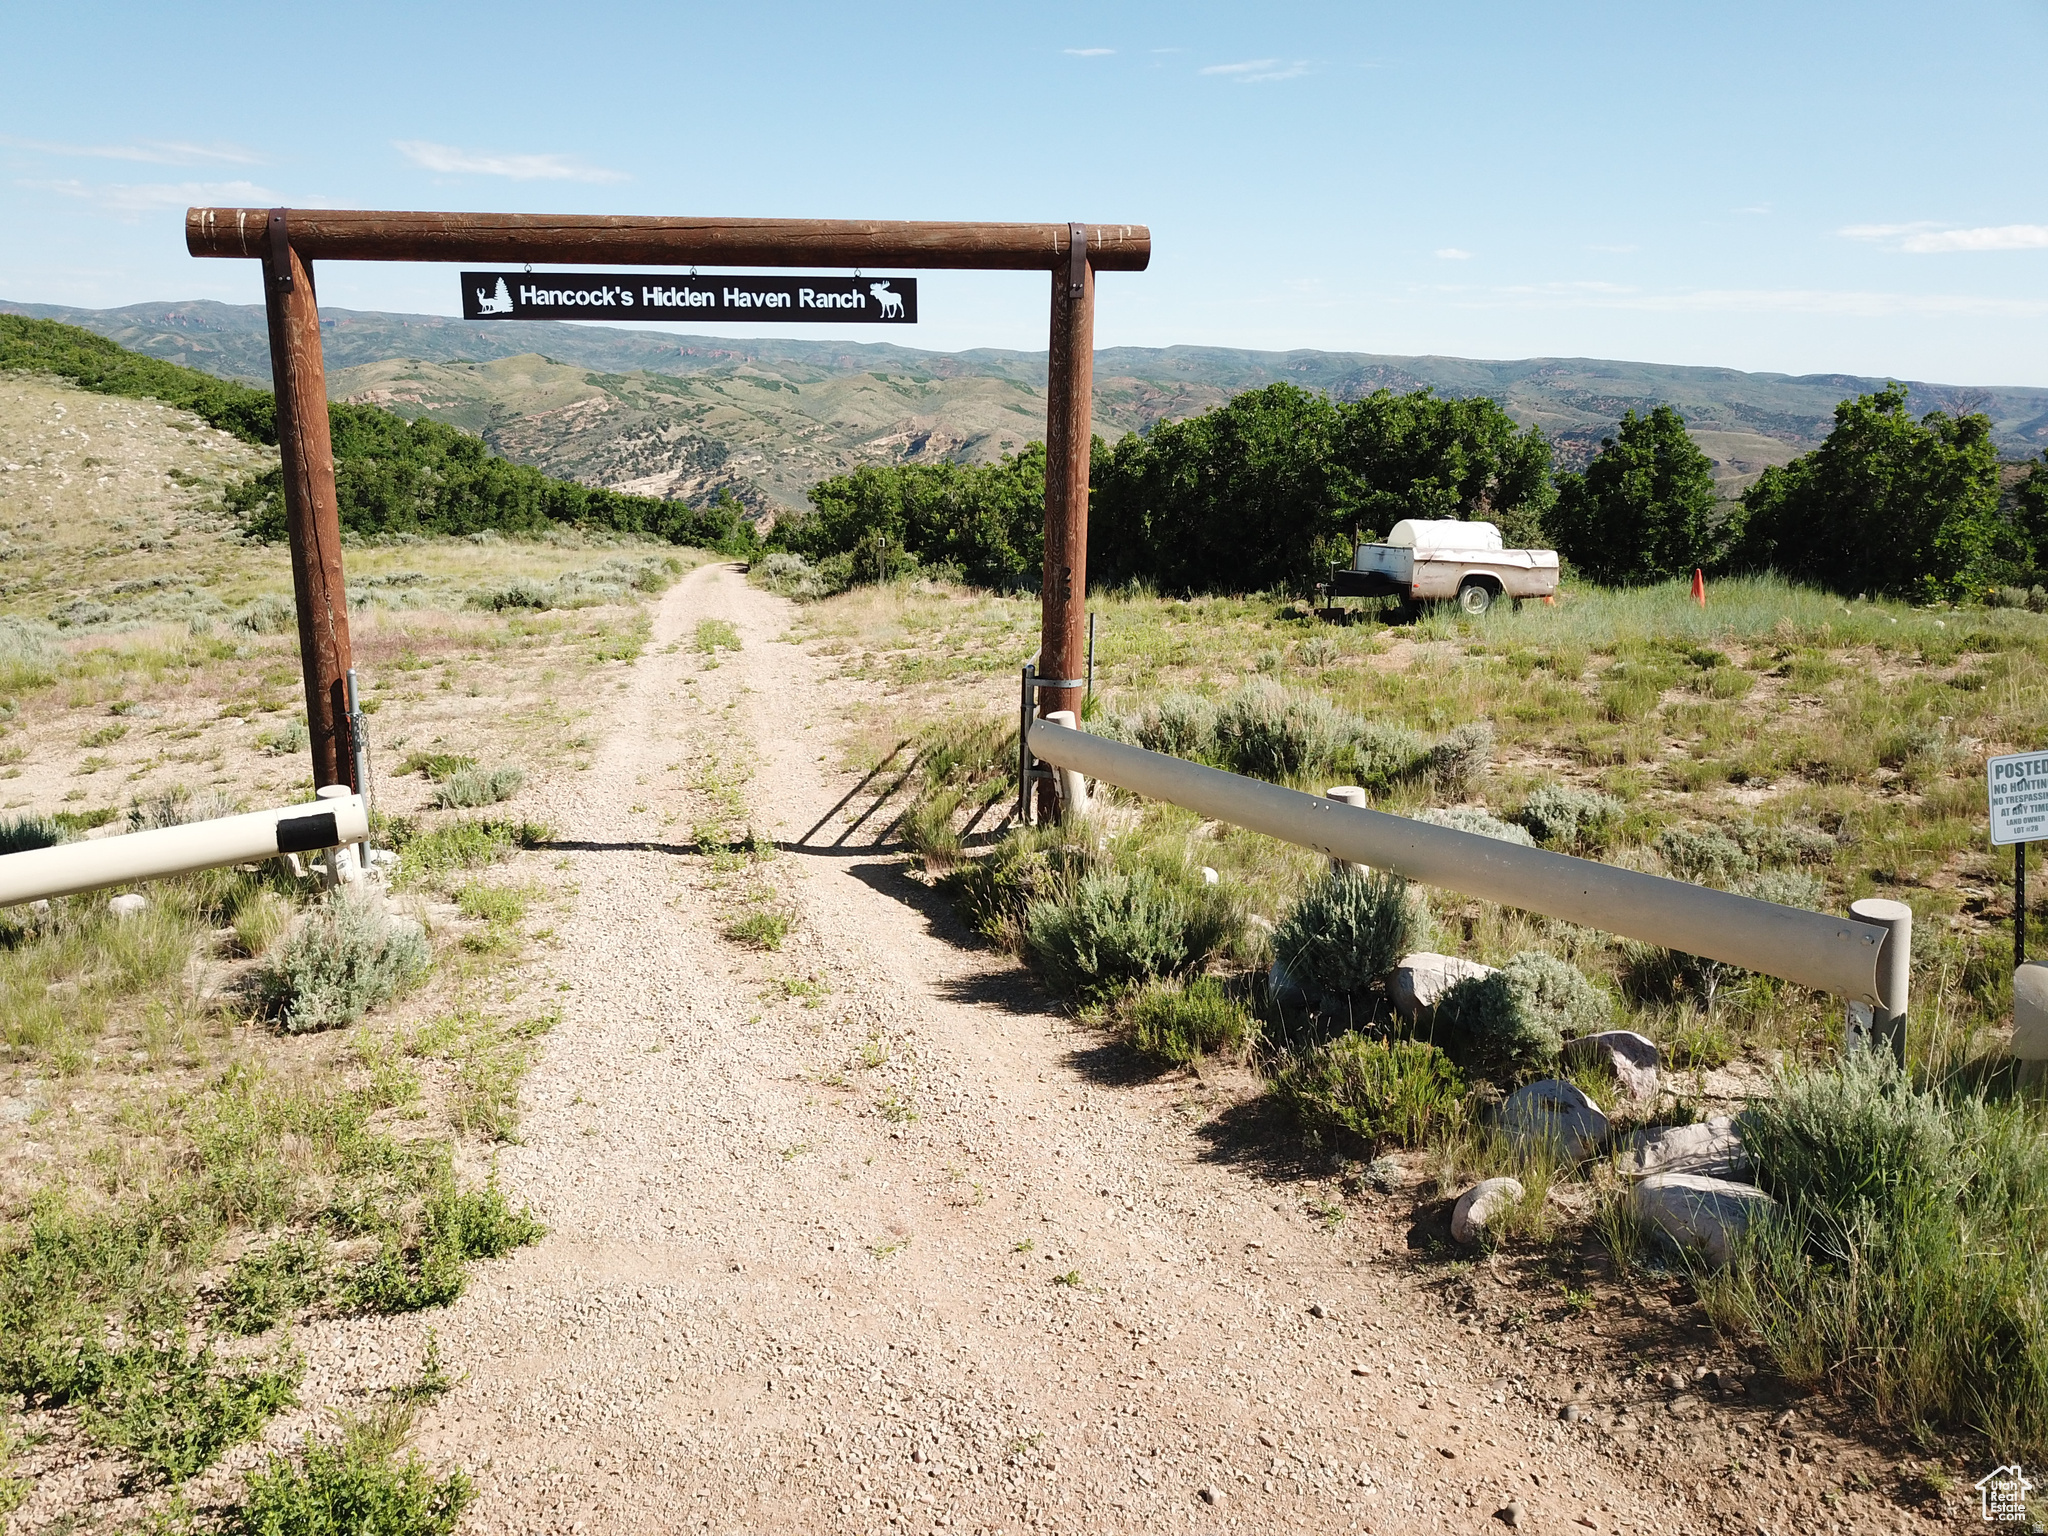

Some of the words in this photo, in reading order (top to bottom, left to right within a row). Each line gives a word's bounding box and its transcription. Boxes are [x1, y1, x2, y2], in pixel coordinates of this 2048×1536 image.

[520, 285, 634, 307] Hancock's
[642, 286, 715, 308] Hidden
[723, 287, 791, 308] Haven
[798, 288, 866, 309] Ranch
[1995, 759, 2048, 780] POSTED
[1994, 783, 2008, 795] NO
[2010, 779, 2048, 793] HUNTIN
[1993, 797, 2004, 806] NO
[2001, 808, 2011, 817] AT
[2012, 805, 2028, 816] ANY
[2006, 818, 2022, 826] LAND
[2023, 815, 2046, 824] OWNER
